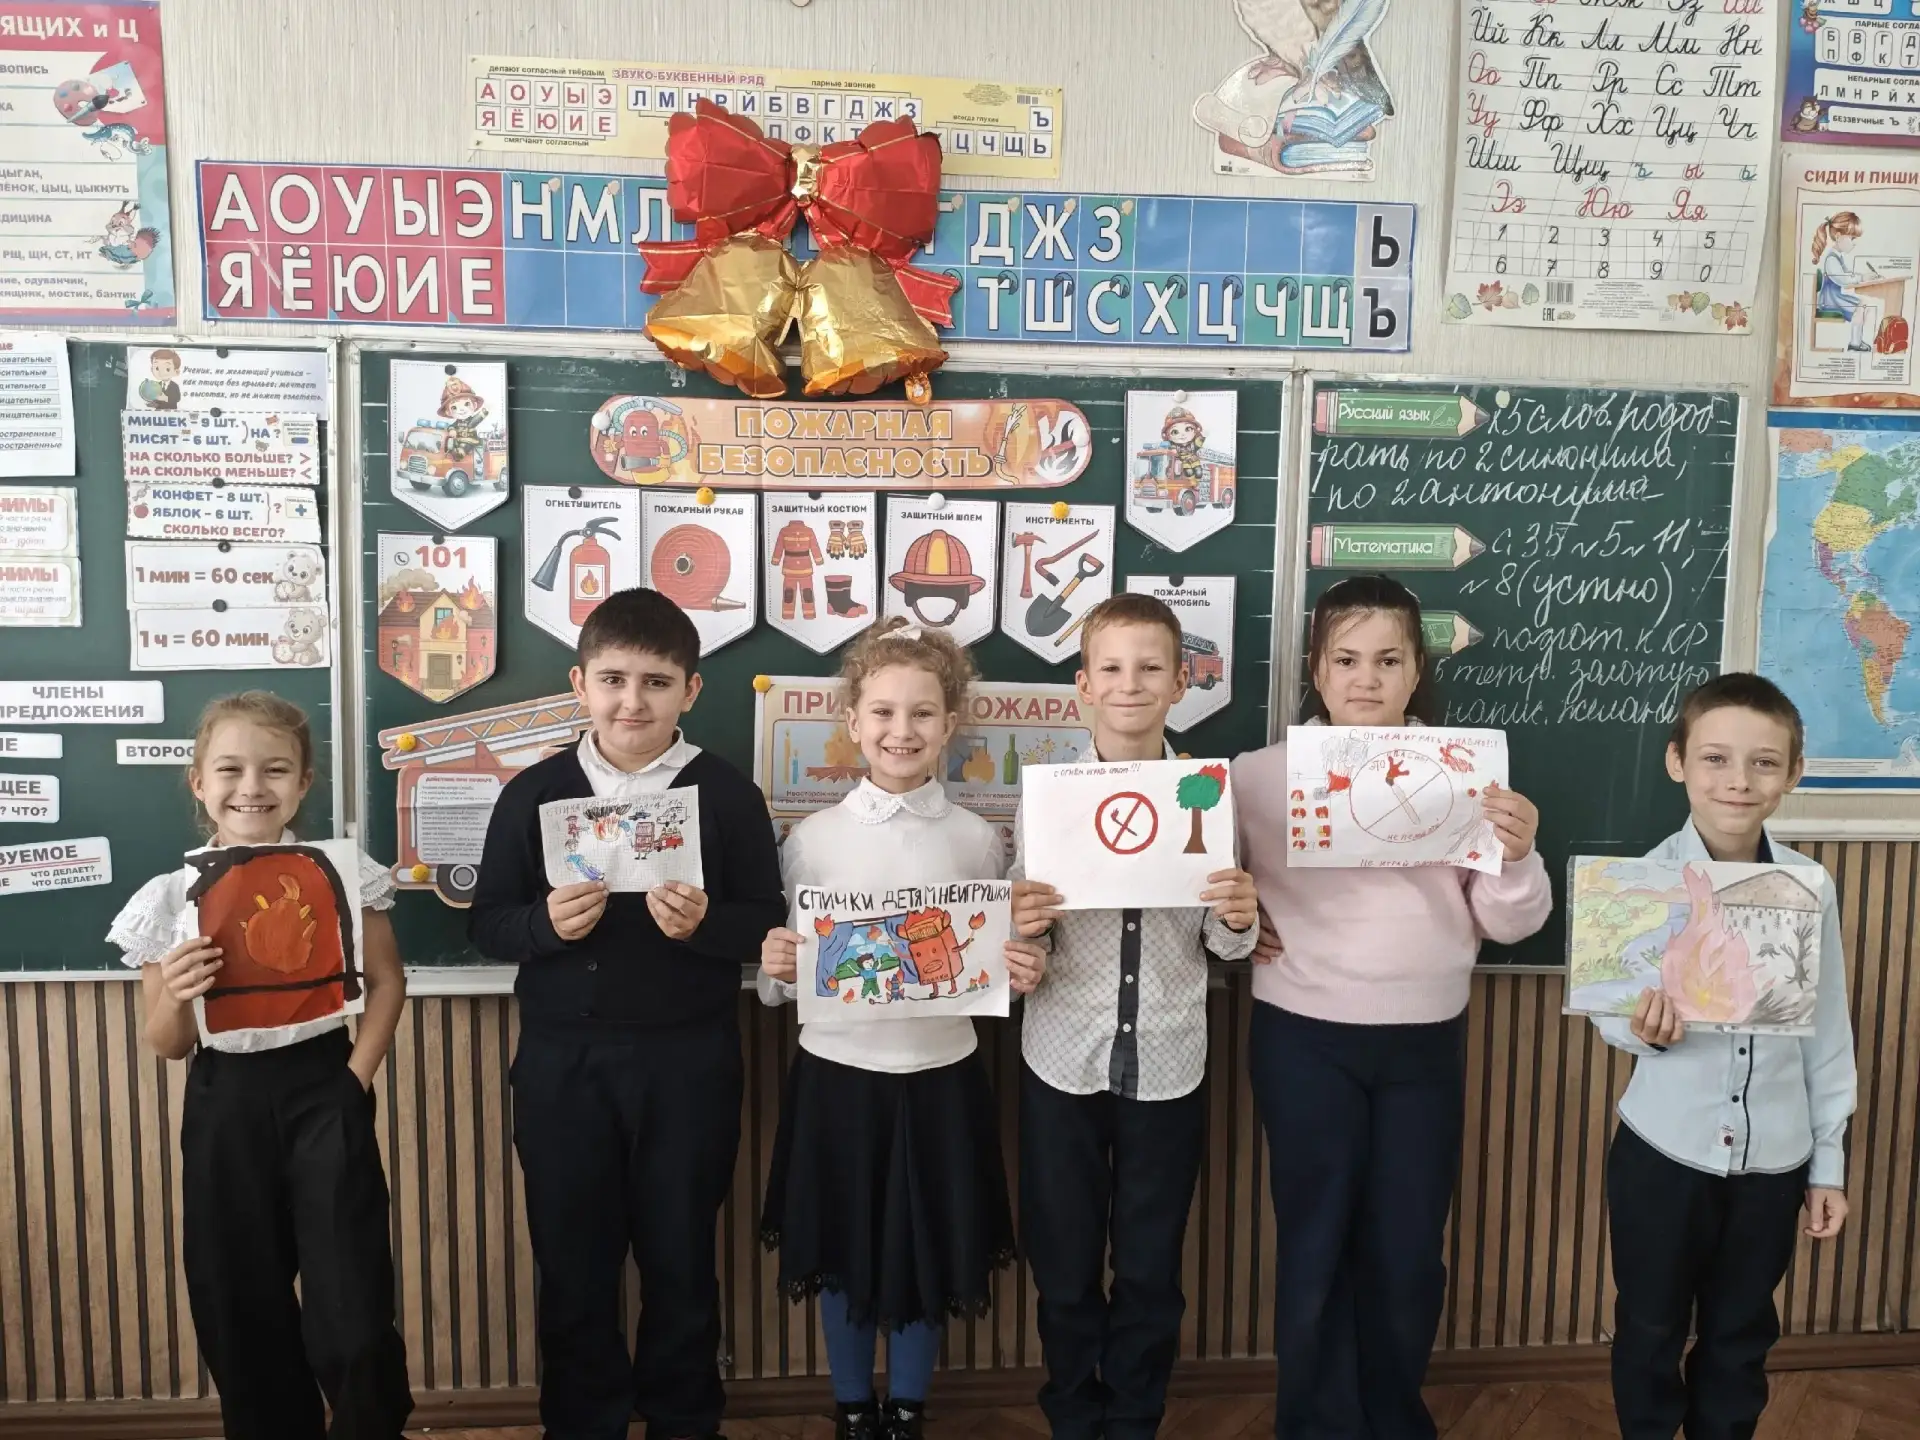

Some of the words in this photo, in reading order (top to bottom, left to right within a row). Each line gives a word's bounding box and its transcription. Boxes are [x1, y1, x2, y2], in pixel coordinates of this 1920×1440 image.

[1471, 6, 1509, 44] Йй
[1523, 14, 1565, 46] Кк
[1580, 18, 1624, 51] Лл
[1639, 21, 1701, 54] Мм
[1718, 24, 1763, 55] Нн
[1855, 20, 1890, 29] ПАРНЫЕ
[118, 19, 139, 43] Ц
[488, 65, 519, 73] делают
[522, 67, 567, 76] согласный
[612, 69, 736, 84] ЗВУКО-БУКВЕННЫЙ
[739, 75, 765, 86] РЯД
[1468, 52, 1502, 86] Оо
[1519, 56, 1562, 90] Пп
[1592, 61, 1628, 104] Рр
[1655, 64, 1683, 96] Сс
[1703, 65, 1762, 97] Тт
[1847, 75, 1891, 84] НЕПАРНЫЕ
[811, 79, 842, 88] парные
[843, 81, 876, 89] звонкие
[1833, 115, 1885, 125] БЕЗЗВУЧНЫЕ
[504, 137, 544, 145] смягчают
[545, 139, 589, 147] согласный
[1804, 170, 1849, 185] СИДИ
[1854, 170, 1865, 183] И
[1869, 171, 1918, 185] ПИШИ
[75, 184, 130, 194] ЦЫКНУТЬ
[209, 173, 260, 233] А
[269, 173, 323, 234] О
[330, 174, 376, 236] У
[390, 178, 440, 236] Ы
[454, 179, 494, 239] Э
[510, 181, 553, 241] Н
[565, 184, 622, 245] М
[630, 185, 672, 245] Л
[969, 202, 1017, 265] Д
[1022, 203, 1076, 262] Ж
[1087, 205, 1124, 264] З
[1370, 215, 1401, 270] Ь
[214, 253, 253, 310] Я
[280, 244, 314, 312] Ё
[333, 257, 385, 313] Ю
[396, 255, 440, 315] И
[459, 257, 494, 317] Е
[976, 276, 1014, 331] Т
[1024, 277, 1073, 333] Ш
[1086, 278, 1123, 336] С
[1139, 280, 1181, 335] Х
[1198, 282, 1237, 342] Ц
[1253, 283, 1289, 338] Ч
[1301, 284, 1352, 345] Щ
[1361, 287, 1398, 339] Ъ
[1338, 402, 1393, 421] Русский
[1399, 409, 1431, 422] язык
[128, 416, 187, 428] МИШЕК
[201, 418, 209, 428] 9
[214, 418, 239, 428] ШТ.
[735, 406, 953, 441] ПОЖАРНАЯ
[251, 428, 271, 439] НА
[128, 434, 179, 445] ЛИСЯТ
[193, 435, 202, 445] 6
[206, 436, 232, 446] ШТ.
[130, 452, 150, 462] НА
[154, 452, 221, 463] СКОЛЬКО
[225, 453, 294, 464] БОЛЬШЕ?
[698, 443, 994, 479] БЕЗОПАСНОСТЬ
[130, 466, 150, 477] НА
[154, 467, 221, 477] СКОЛЬКО
[225, 468, 297, 478] МЕНЬШЕ?
[152, 489, 214, 502] КОНФЕТ
[227, 492, 235, 502] 8
[240, 493, 265, 504] ШТ.
[545, 499, 623, 510] ОГНЕТУШИТЕЛЬ
[654, 504, 712, 515] ПОЖАРНЫЙ
[713, 506, 744, 516] РУКАВ
[771, 503, 825, 514] ЗАЩИТНЫЙ
[827, 505, 868, 514] КОСТЮМ
[152, 507, 202, 519] ЯБЛОК
[215, 509, 224, 520] 6
[228, 510, 253, 521] ШТ.
[900, 511, 954, 523] ЗАЩИТНЫЙ
[955, 513, 983, 523] ШЛЕМ
[1025, 515, 1095, 527] ИНСТРУМЕНТЫ
[163, 524, 229, 536] СКОЛЬКО
[233, 527, 286, 538] ВСЕГО?
[1334, 537, 1435, 555] Математика
[415, 545, 468, 570] 101
[135, 566, 145, 583] 1
[150, 570, 190, 583] мин
[211, 567, 238, 583] 60
[1153, 587, 1207, 597] ПОЖАРНЫЙ
[140, 631, 149, 647] 1
[154, 634, 167, 647] ч
[191, 629, 220, 647] 60
[32, 686, 104, 699] ЧЛЕНЫ
[12, 806, 48, 816] ЧТО?
[53, 865, 95, 877] ДЕЛАЕТ?
[32, 879, 52, 887] ЧТО
[54, 874, 103, 886] СДЕЛАЕТ?
[799, 888, 875, 912] СПИЧКИ
[882, 885, 936, 912] ДЕТЯМ
